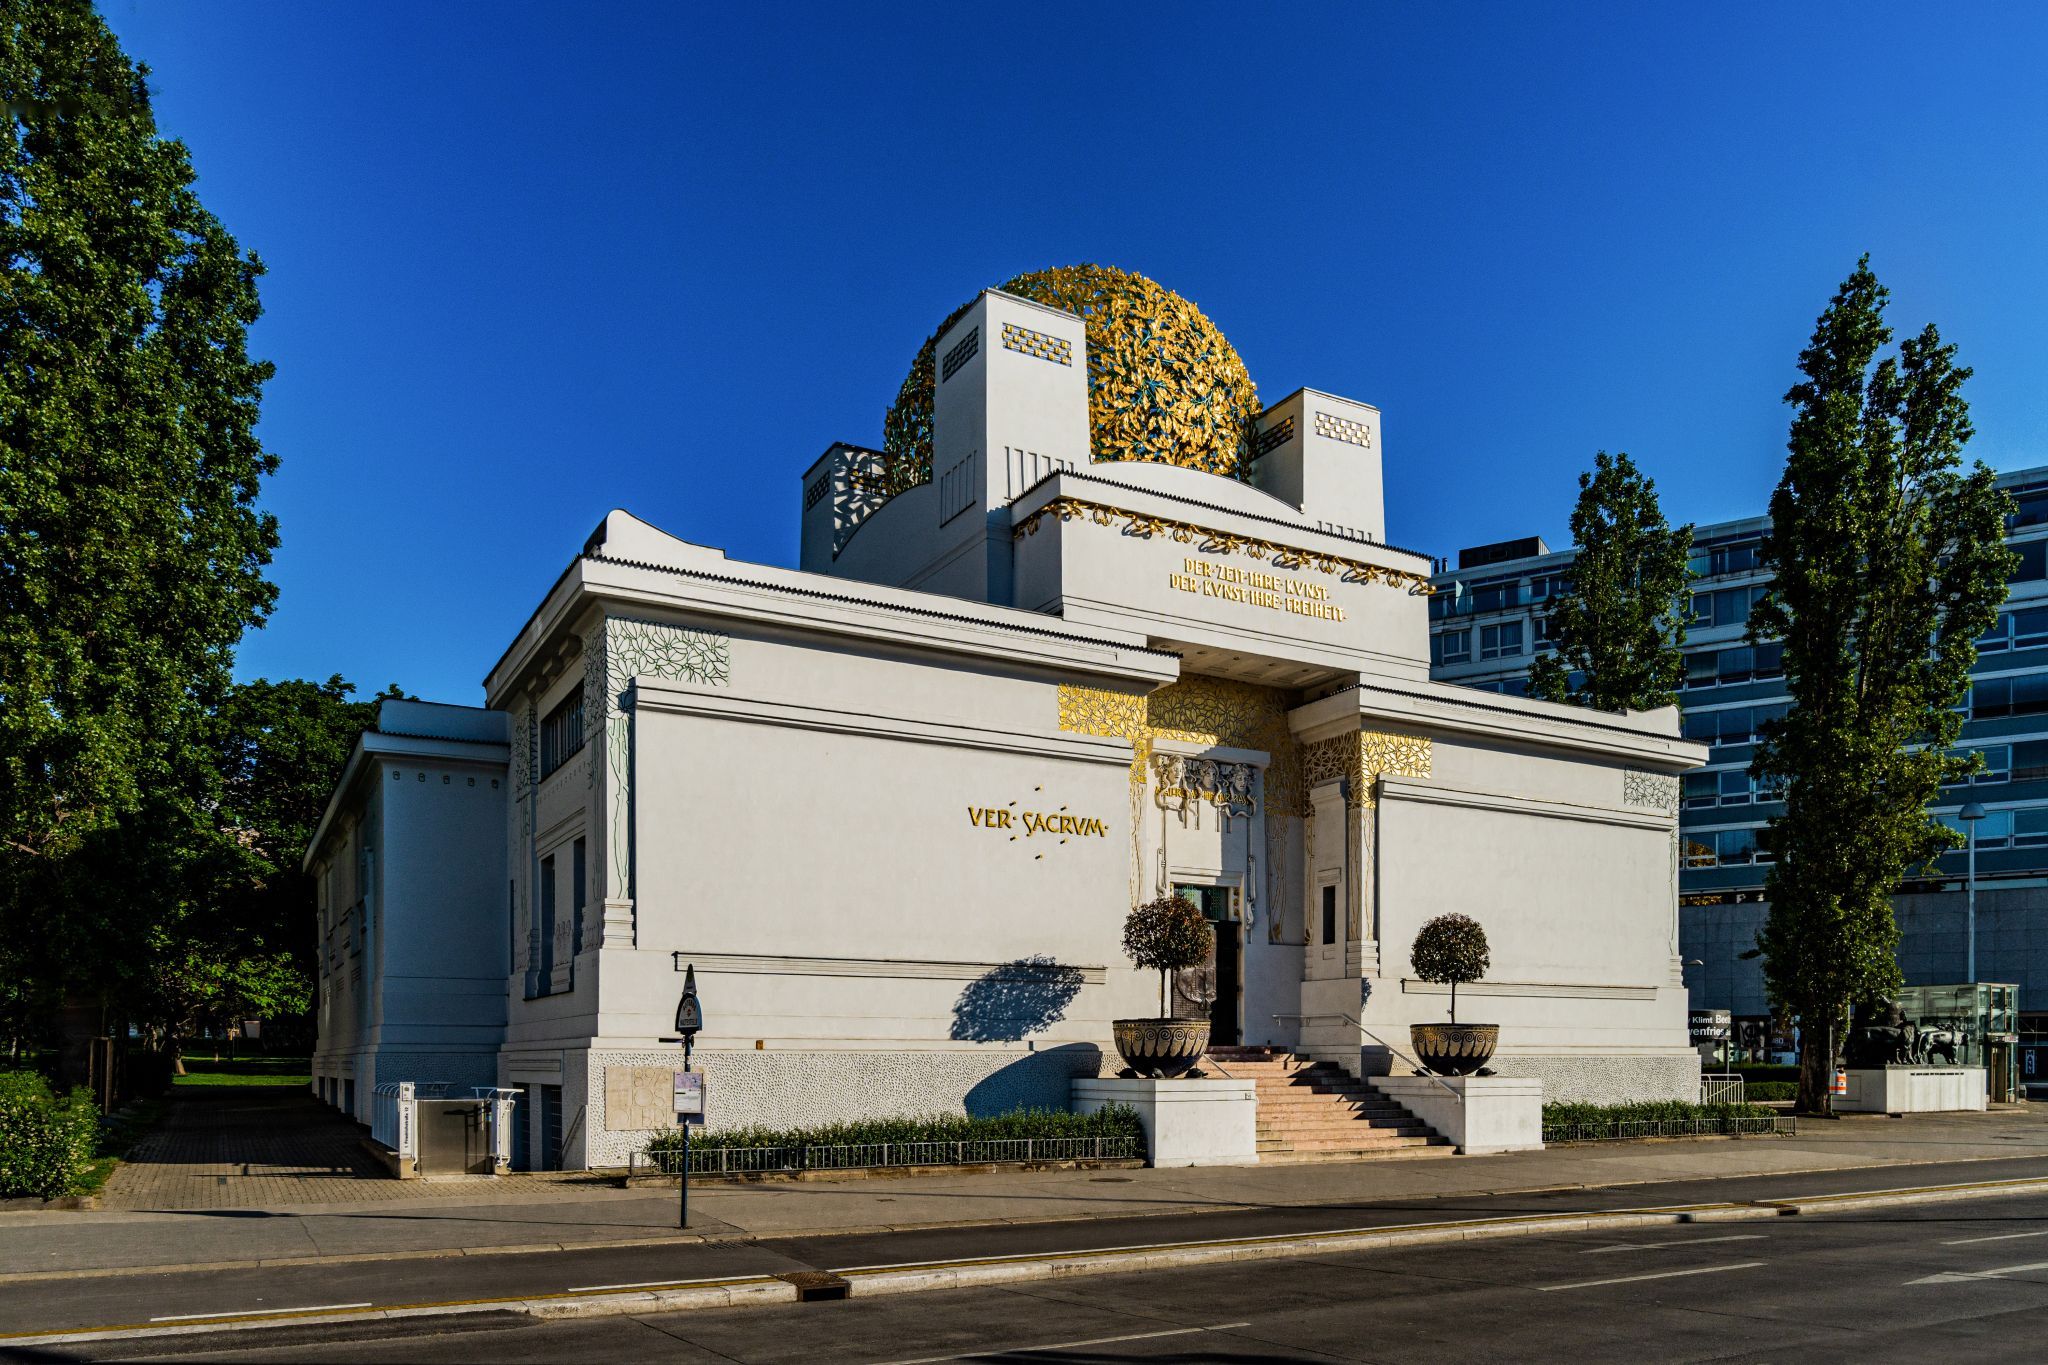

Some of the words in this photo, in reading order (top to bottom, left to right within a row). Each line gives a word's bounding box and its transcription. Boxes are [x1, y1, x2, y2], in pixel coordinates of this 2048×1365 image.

[1184, 557, 1211, 578] DER
[1216, 563, 1246, 584] ZEIT
[1249, 571, 1281, 592] IHRE
[1170, 573, 1197, 593] DER
[1249, 590, 1281, 609] IHRE
[967, 806, 1012, 829] VER
[1692, 1016, 1713, 1024] Klimt
